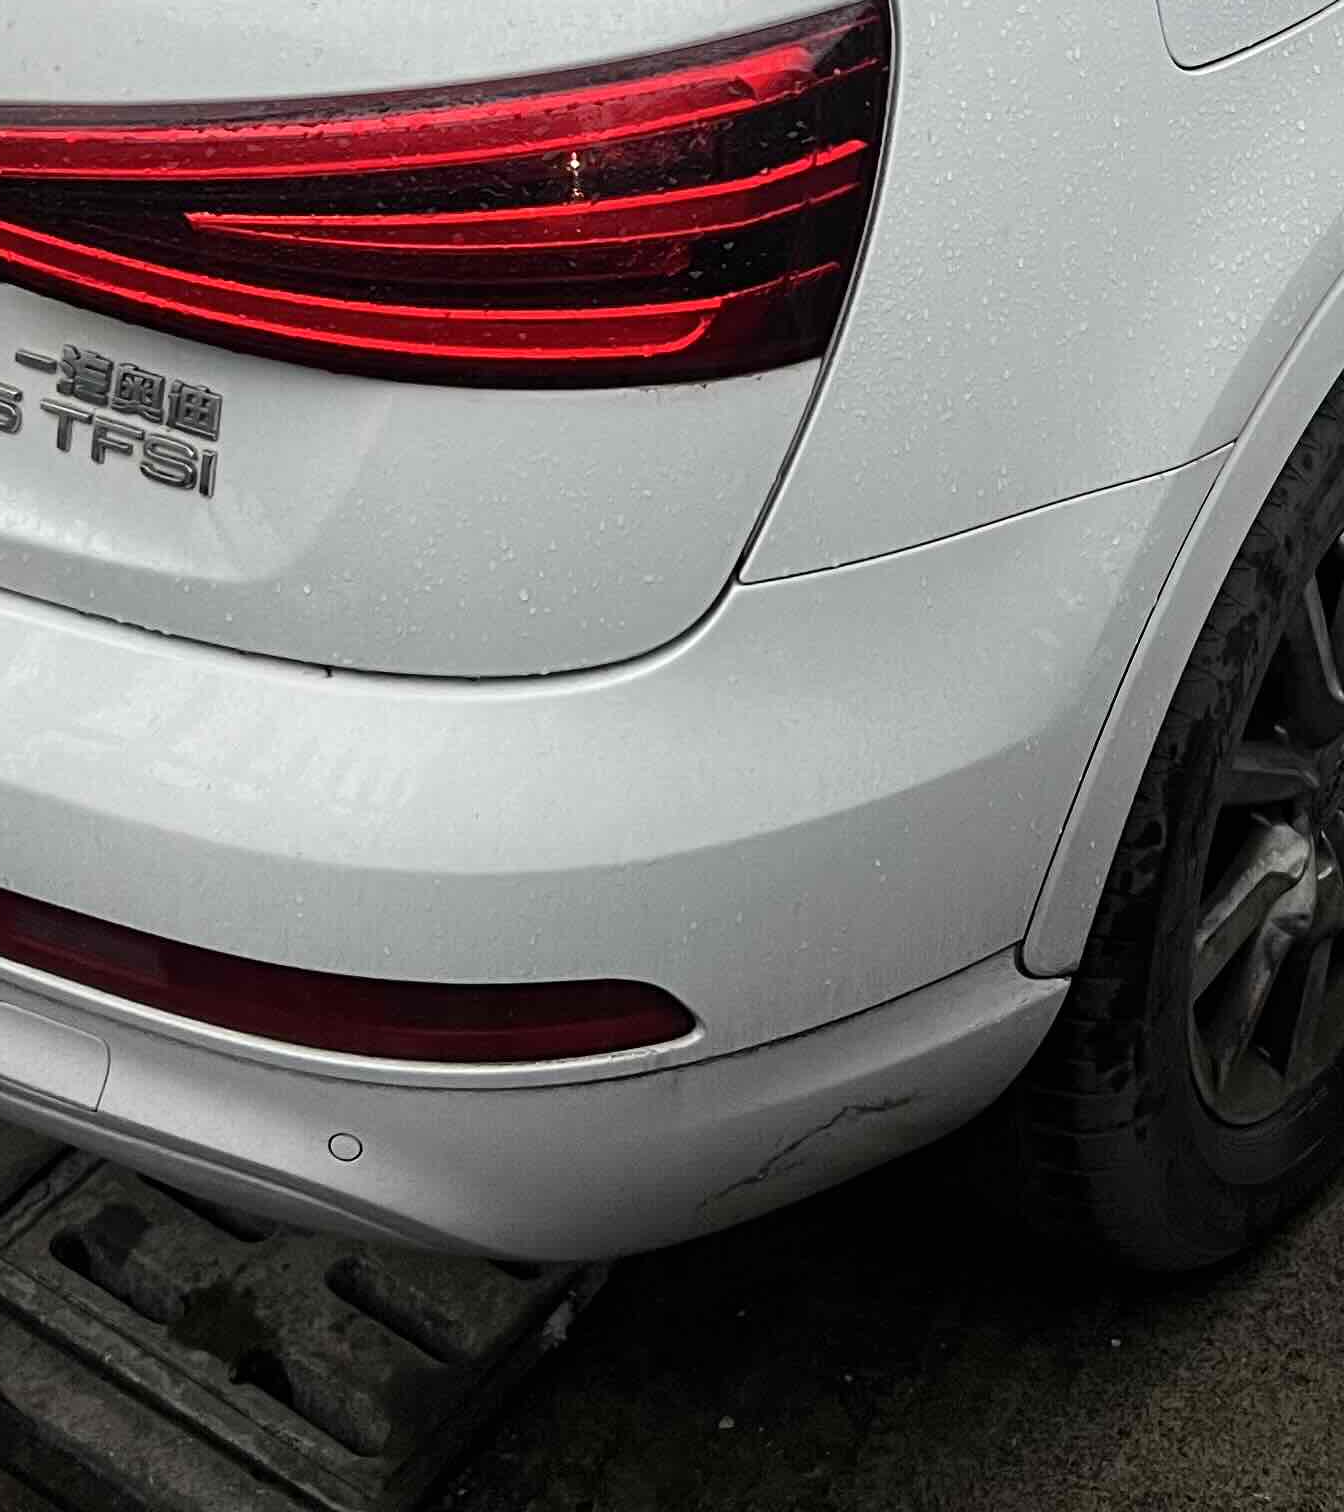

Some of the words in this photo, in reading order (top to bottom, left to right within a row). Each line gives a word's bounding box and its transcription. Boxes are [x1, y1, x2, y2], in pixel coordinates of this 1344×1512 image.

[14, 343, 223, 442] 一汽奥迪
[39, 397, 218, 498] TFSI
